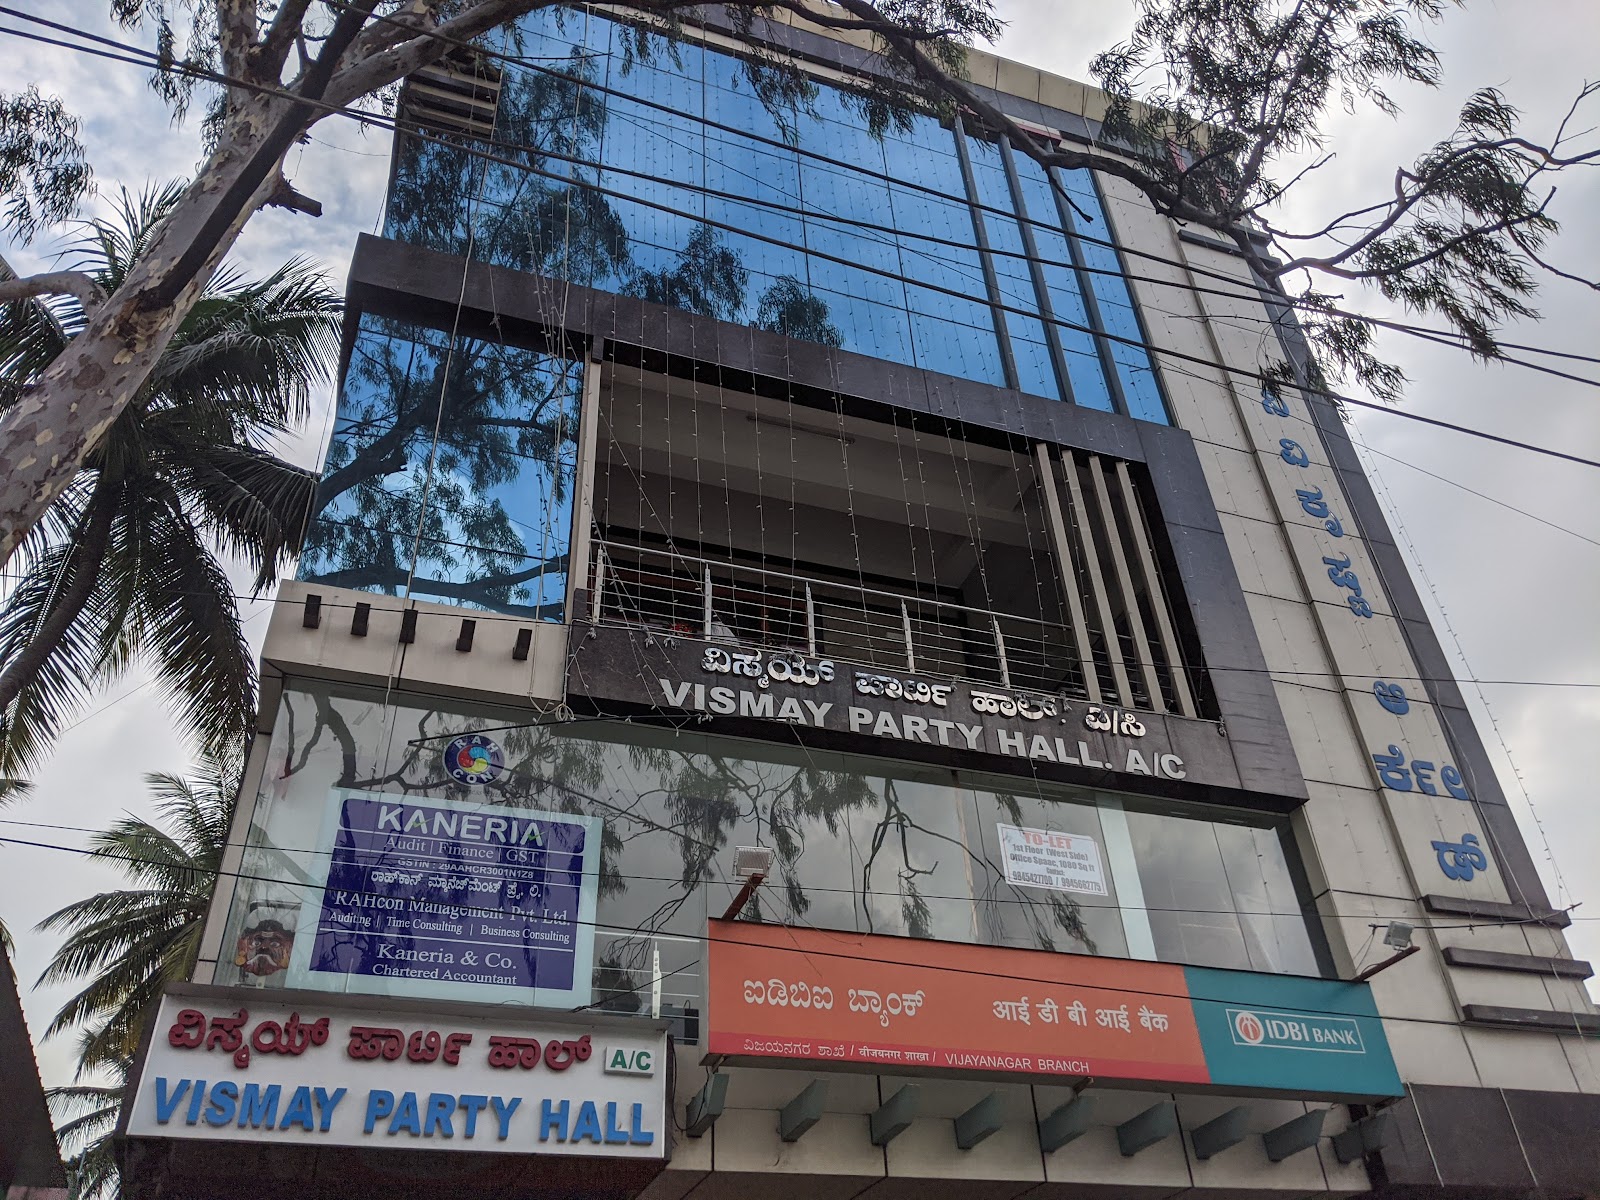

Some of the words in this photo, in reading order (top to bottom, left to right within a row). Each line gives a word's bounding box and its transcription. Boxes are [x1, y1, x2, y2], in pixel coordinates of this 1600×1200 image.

[700, 647, 835, 689] ವಿಸ್ಮಯ್
[854, 671, 952, 708] ಪಾರ್ಟಿ
[659, 678, 833, 728] VISMAY
[848, 706, 984, 750] PARTY
[998, 728, 1113, 769] HALL.
[1125, 748, 1187, 781] A/C
[454, 736, 499, 753] RAH
[452, 768, 494, 784] CON
[378, 805, 544, 847] KANERIA
[384, 837, 427, 852] Audit
[438, 841, 494, 858] Finance
[506, 848, 539, 863] GST
[1012, 843, 1024, 852] 1st
[1025, 845, 1044, 854] Floor
[1023, 832, 1072, 850] TO-LET
[398, 858, 430, 869] GSTIN
[1010, 853, 1032, 863] Office
[1059, 860, 1077, 869] 1080
[1078, 863, 1088, 872] Sq
[334, 890, 404, 911] RAHcon
[510, 905, 537, 923] Pvt.
[543, 908, 571, 926] Ltd.
[328, 912, 372, 927] Auditing
[386, 915, 411, 929] Time
[413, 918, 463, 934] Consulting
[481, 925, 519, 938] Business
[522, 927, 570, 944] Consulting
[376, 944, 455, 965] Kaneria
[460, 950, 479, 966] &
[485, 952, 517, 970] Co.
[372, 963, 439, 980] Chartered
[442, 968, 517, 985] Accountant
[743, 978, 834, 1010] ಐಡಿಬಿಐ
[847, 988, 926, 1028] ಬ್ಯಾಂಕ್
[992, 996, 1031, 1026] आई
[1036, 997, 1059, 1024] डी
[1066, 1000, 1088, 1027] बी
[1095, 1004, 1132, 1033] आई
[1137, 1005, 1169, 1033] बैंक
[167, 1007, 331, 1069] ವಿಸ್ಮಯ್
[347, 1024, 473, 1066] ಪಾರ್ಟಿ
[488, 1033, 592, 1071] ಹಾಲ್
[1265, 1019, 1310, 1042] IDBI
[1312, 1027, 1358, 1045] BANK
[610, 1051, 652, 1073] A/C
[743, 1038, 811, 1055] ವಿಜಯನಗರ
[817, 1044, 845, 1057] ಶಾಖೆ
[904, 1051, 929, 1062] शाखा
[944, 1053, 1032, 1069] VIJAYANAGAR
[1038, 1058, 1090, 1073] BRANCH
[154, 1076, 347, 1132] VISMAY
[363, 1088, 523, 1139] PARTY
[539, 1098, 654, 1145] HALL
